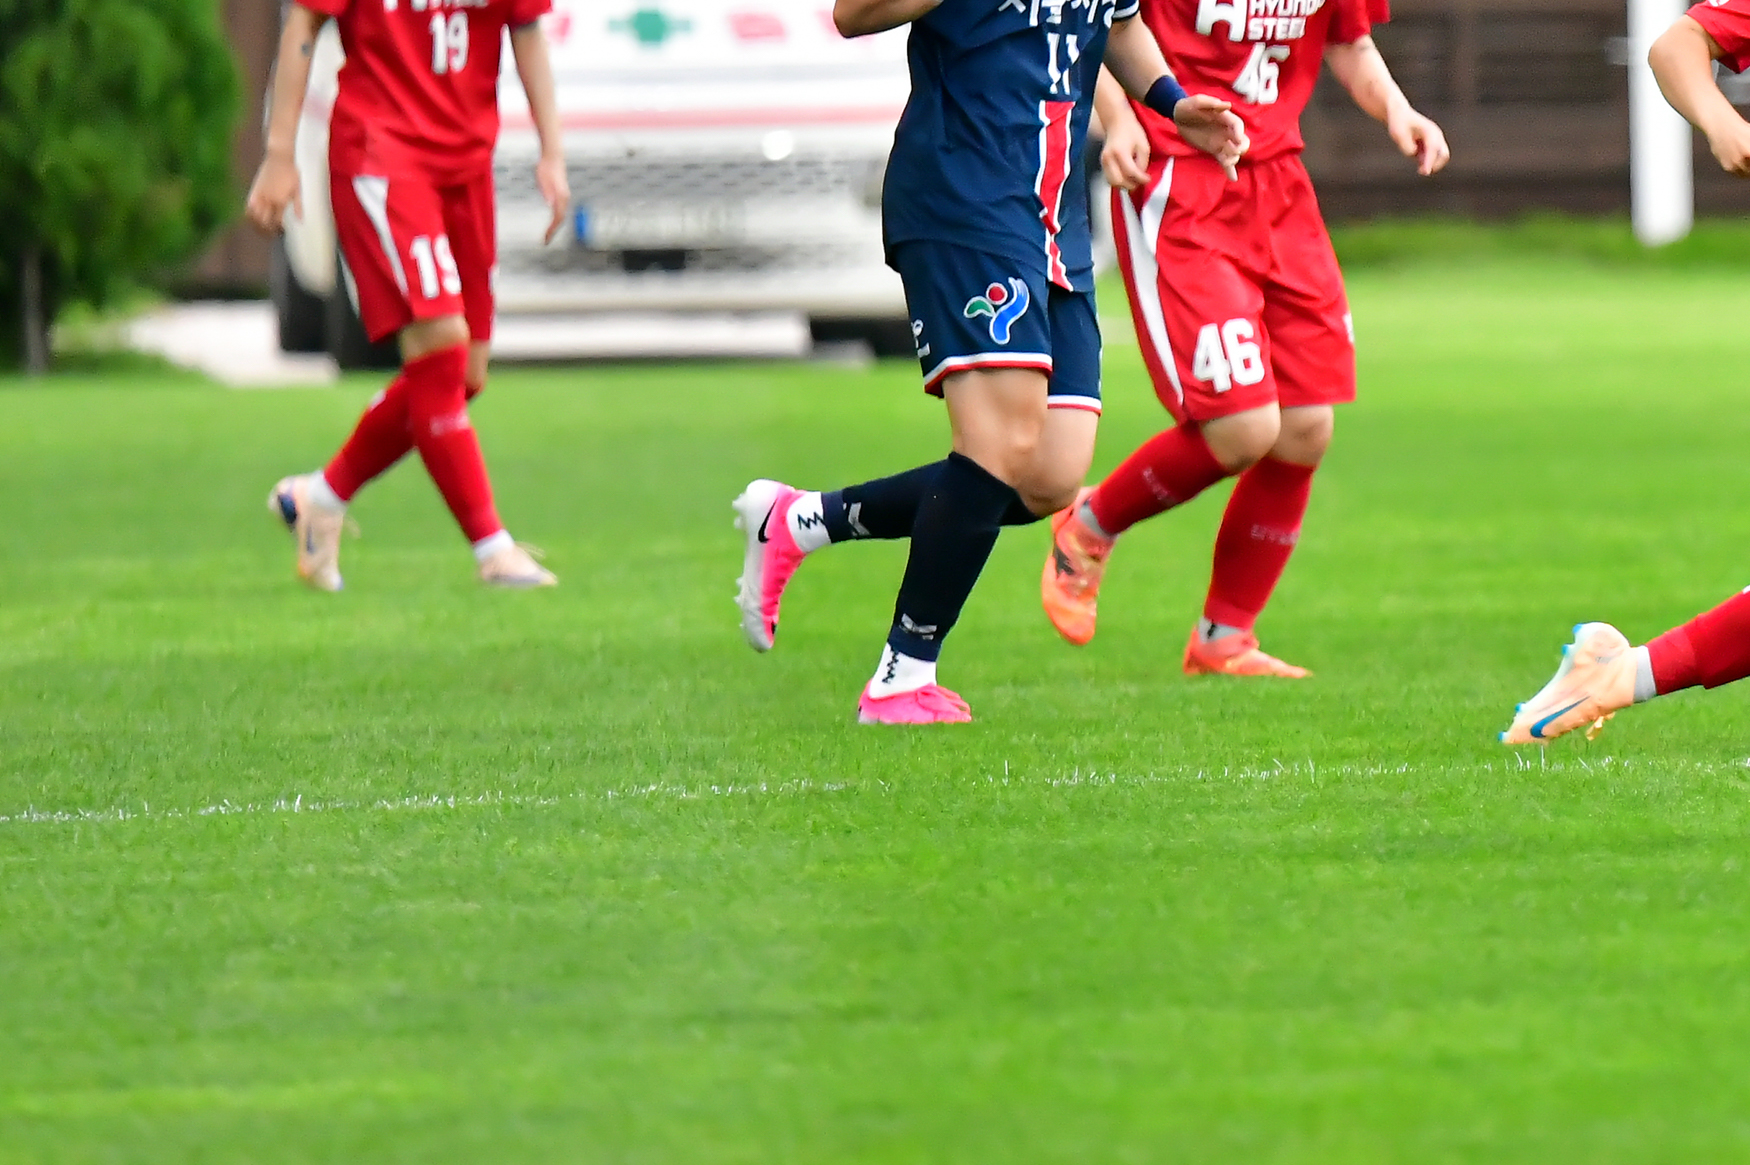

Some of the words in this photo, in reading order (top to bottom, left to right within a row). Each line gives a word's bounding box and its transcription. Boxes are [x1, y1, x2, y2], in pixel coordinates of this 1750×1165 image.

[430, 11, 470, 75] 19
[1232, 42, 1290, 105] 46
[1193, 318, 1265, 394] 46
